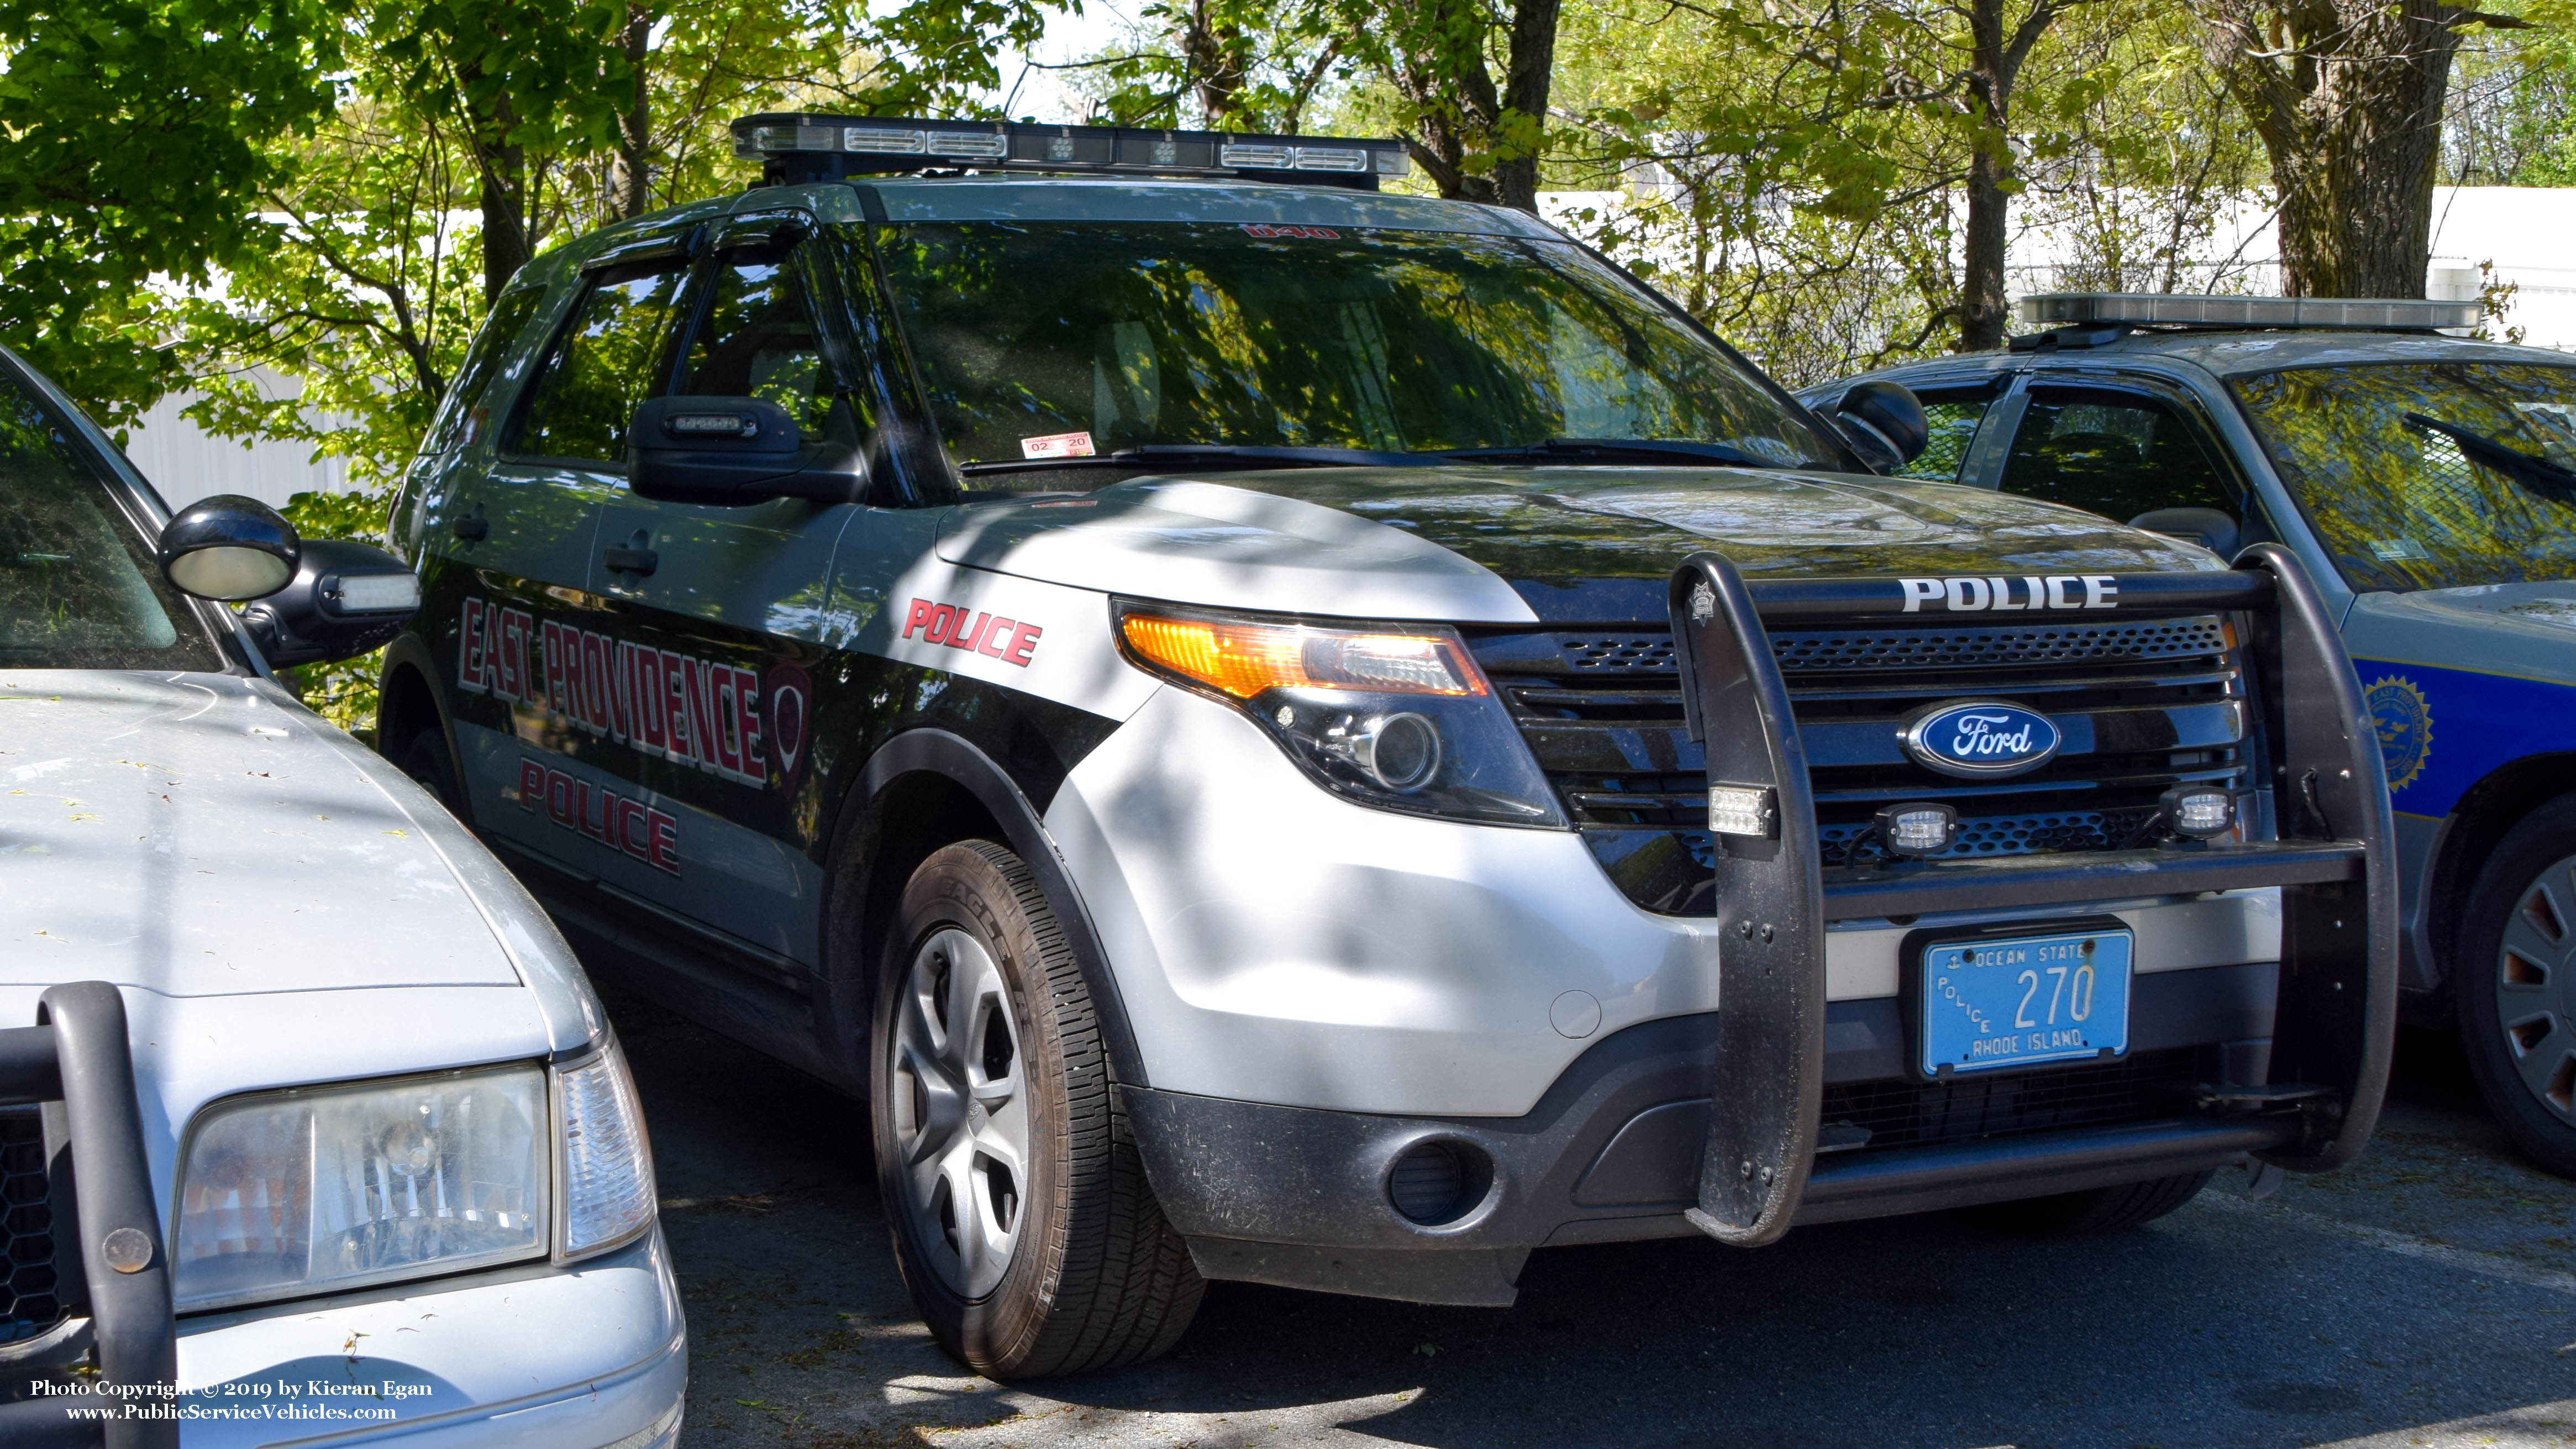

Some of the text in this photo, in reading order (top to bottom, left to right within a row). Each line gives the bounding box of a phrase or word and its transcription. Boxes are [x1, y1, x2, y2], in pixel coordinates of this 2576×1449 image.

[1031, 443, 1048, 452] 02
[1068, 438, 1085, 447] 20
[1897, 575, 2118, 612] POLICE
[902, 597, 1043, 668] POLICE
[458, 596, 767, 790] EAST PROVIDENCE
[1953, 715, 2032, 755] Ford
[519, 757, 681, 878] POLICE
[940, 879, 1011, 962] EAGLE
[1975, 943, 2084, 968] OCEAN STATE
[1937, 977, 1991, 1033] POLICE
[2014, 965, 2094, 1029] 270
[1973, 1028, 2081, 1057] RHODE ISLAND
